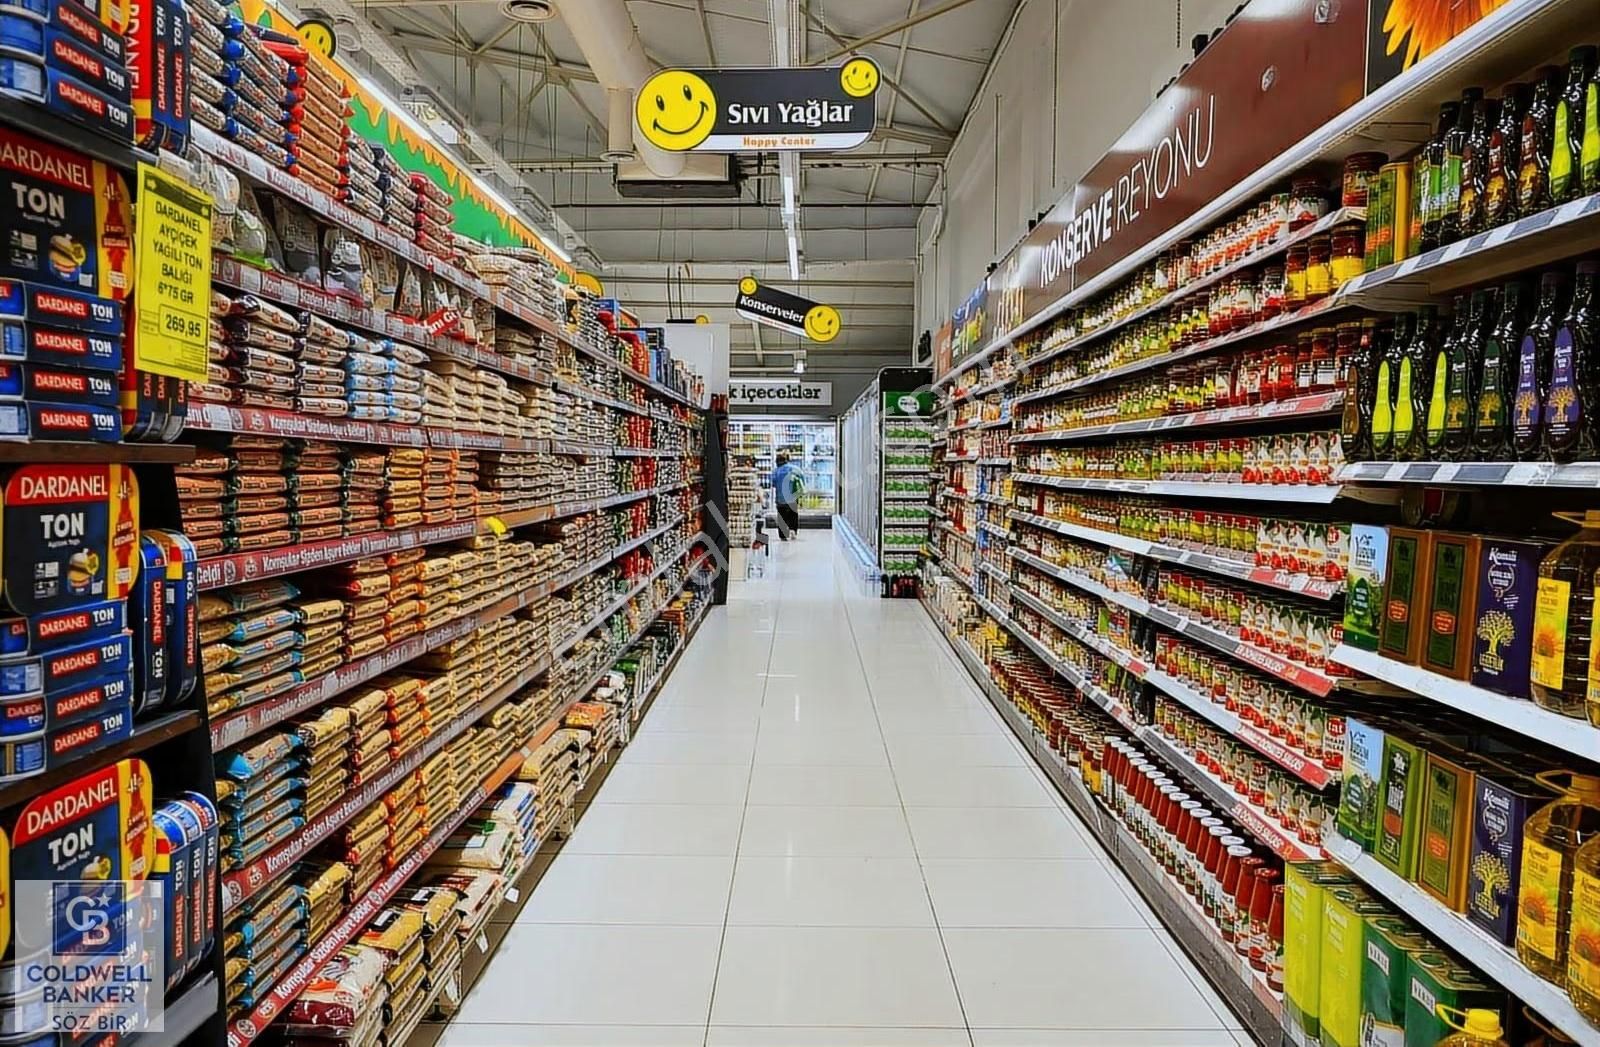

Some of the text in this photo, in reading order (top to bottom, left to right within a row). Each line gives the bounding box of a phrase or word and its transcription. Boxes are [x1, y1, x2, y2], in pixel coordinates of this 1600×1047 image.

[58, 5, 120, 52] DARDANEL TON
[156, 7, 166, 37] TON
[174, 16, 182, 46] TON
[55, 41, 125, 88] DARDANEL TON
[58, 82, 128, 124] DARDANEL TON
[728, 100, 853, 126] Sıvı Yağlar
[743, 136, 816, 146] Happy Center
[0, 145, 92, 189] ARDANEL
[11, 182, 65, 219] TON
[1040, 94, 1215, 288] KONSERVE REYONU
[155, 201, 202, 232] DARDANEL
[184, 251, 203, 269] TON
[37, 296, 114, 319] DARDANEL TON
[180, 289, 194, 304] GR
[740, 296, 805, 323] Konserveler
[165, 314, 202, 337] 269,95
[35, 333, 112, 354] DARDANEL TON
[35, 371, 112, 391] DARDANEL TON
[741, 385, 822, 402] içecekler
[41, 412, 115, 428] DARDANEL TON
[21, 476, 108, 500] DARDANEL
[40, 512, 84, 540] TON
[196, 564, 221, 586] Geldi
[39, 617, 89, 637] DARDANEL
[93, 607, 115, 622] TON
[154, 580, 162, 642] DARDANEL
[52, 643, 122, 675] DARDANEL TON
[155, 648, 163, 678] TON
[56, 680, 124, 715] DARDANEL TON
[54, 713, 123, 751] DARDANEL TON
[1328, 721, 1343, 733] tat
[27, 778, 117, 834] DARDANEL
[48, 824, 94, 865] TON
[265, 838, 303, 873] Komşular
[274, 957, 315, 999] Komşular
